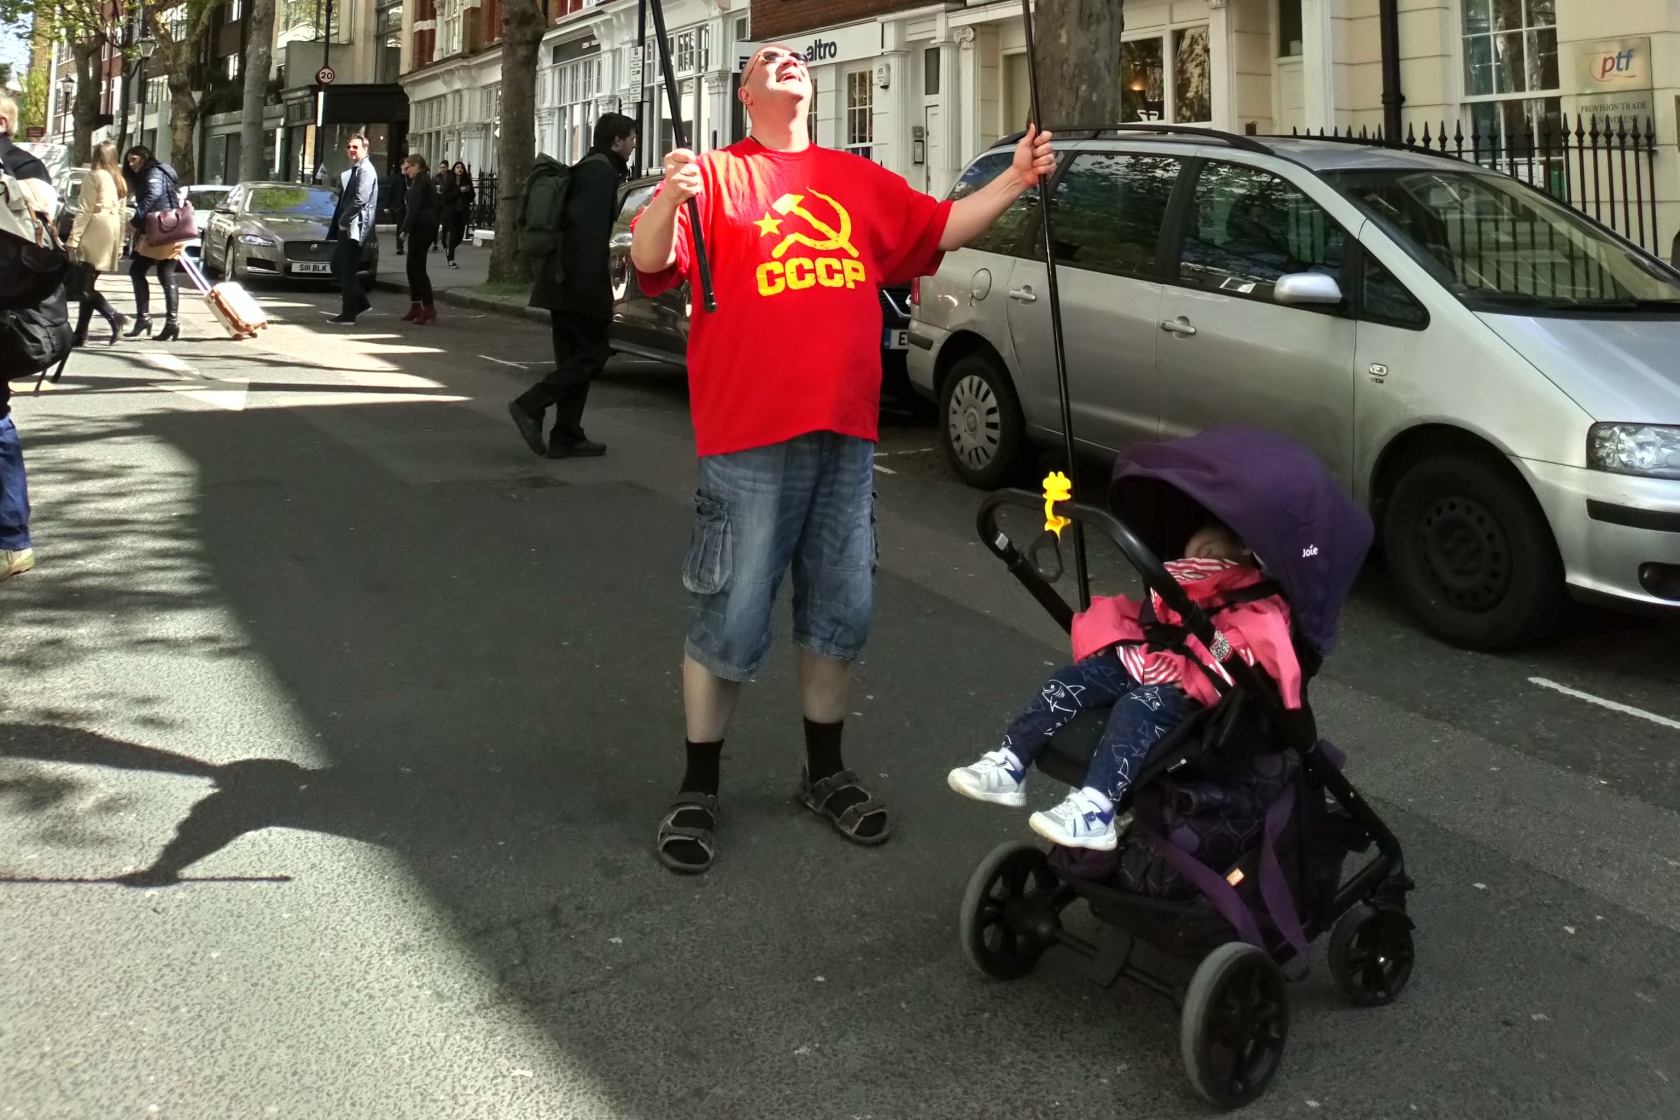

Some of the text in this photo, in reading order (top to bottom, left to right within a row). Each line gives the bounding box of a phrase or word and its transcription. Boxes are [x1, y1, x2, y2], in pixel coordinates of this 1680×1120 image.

[806, 39, 837, 62] altro
[1600, 49, 1634, 79] ptf
[320, 71, 333, 80] 20
[1580, 100, 1648, 113] PROVISION TRADE
[312, 264, 328, 272] BLK
[1302, 544, 1318, 558] Joie
